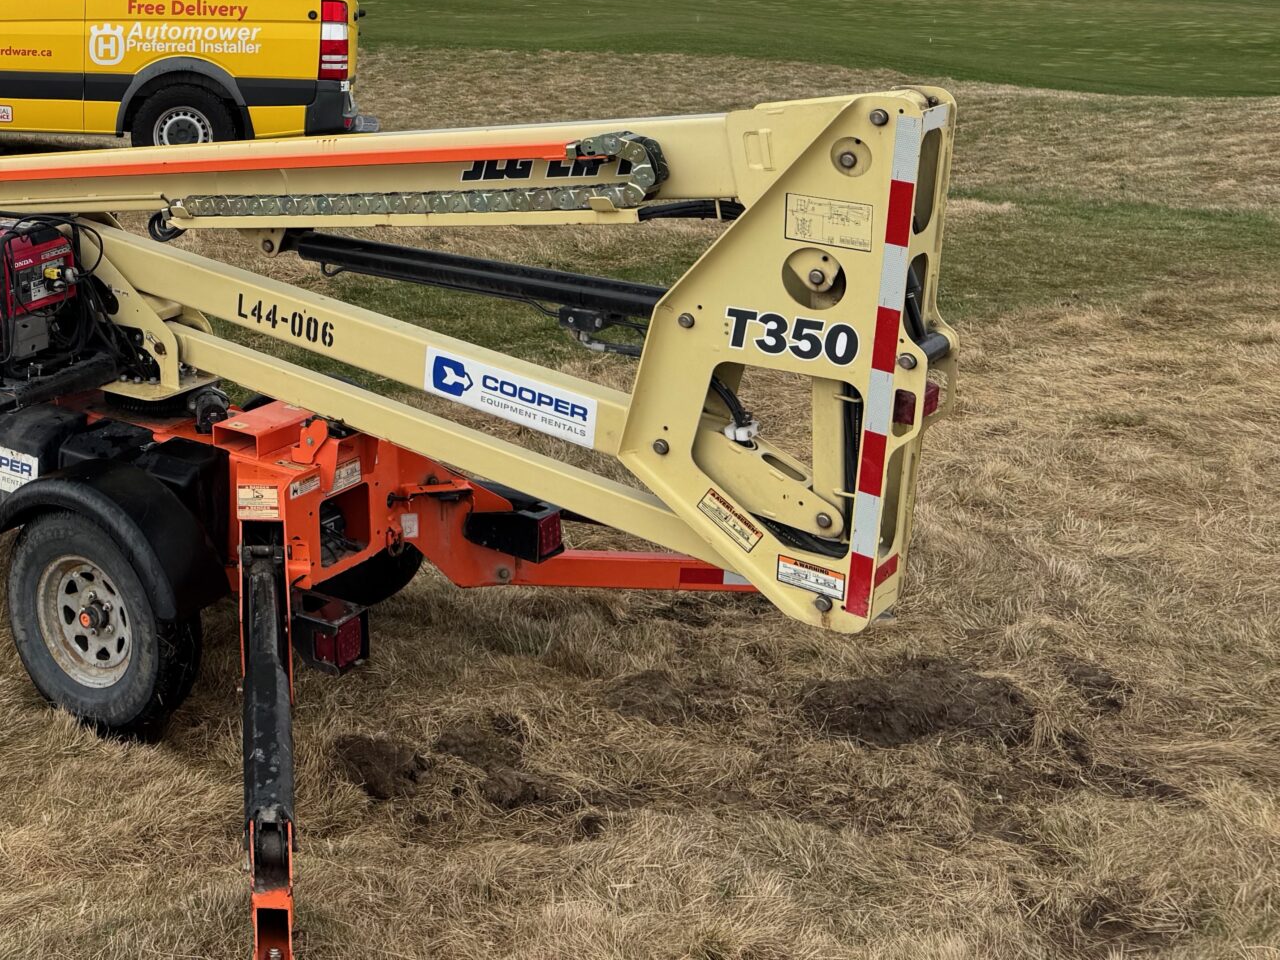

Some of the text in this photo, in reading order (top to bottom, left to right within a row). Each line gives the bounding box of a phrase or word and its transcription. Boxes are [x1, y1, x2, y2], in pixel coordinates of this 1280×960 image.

[127, 0, 248, 21] Free Delivery
[126, 21, 262, 41] Automower
[126, 39, 262, 54] Preferred Installer
[13, 257, 34, 269] ONDA
[237, 292, 335, 348] L44-006
[726, 307, 859, 366] T350
[482, 374, 588, 422] COOPER
[480, 395, 586, 437] EQUIPMENT RENTALS
[1, 474, 23, 487] RENTA
